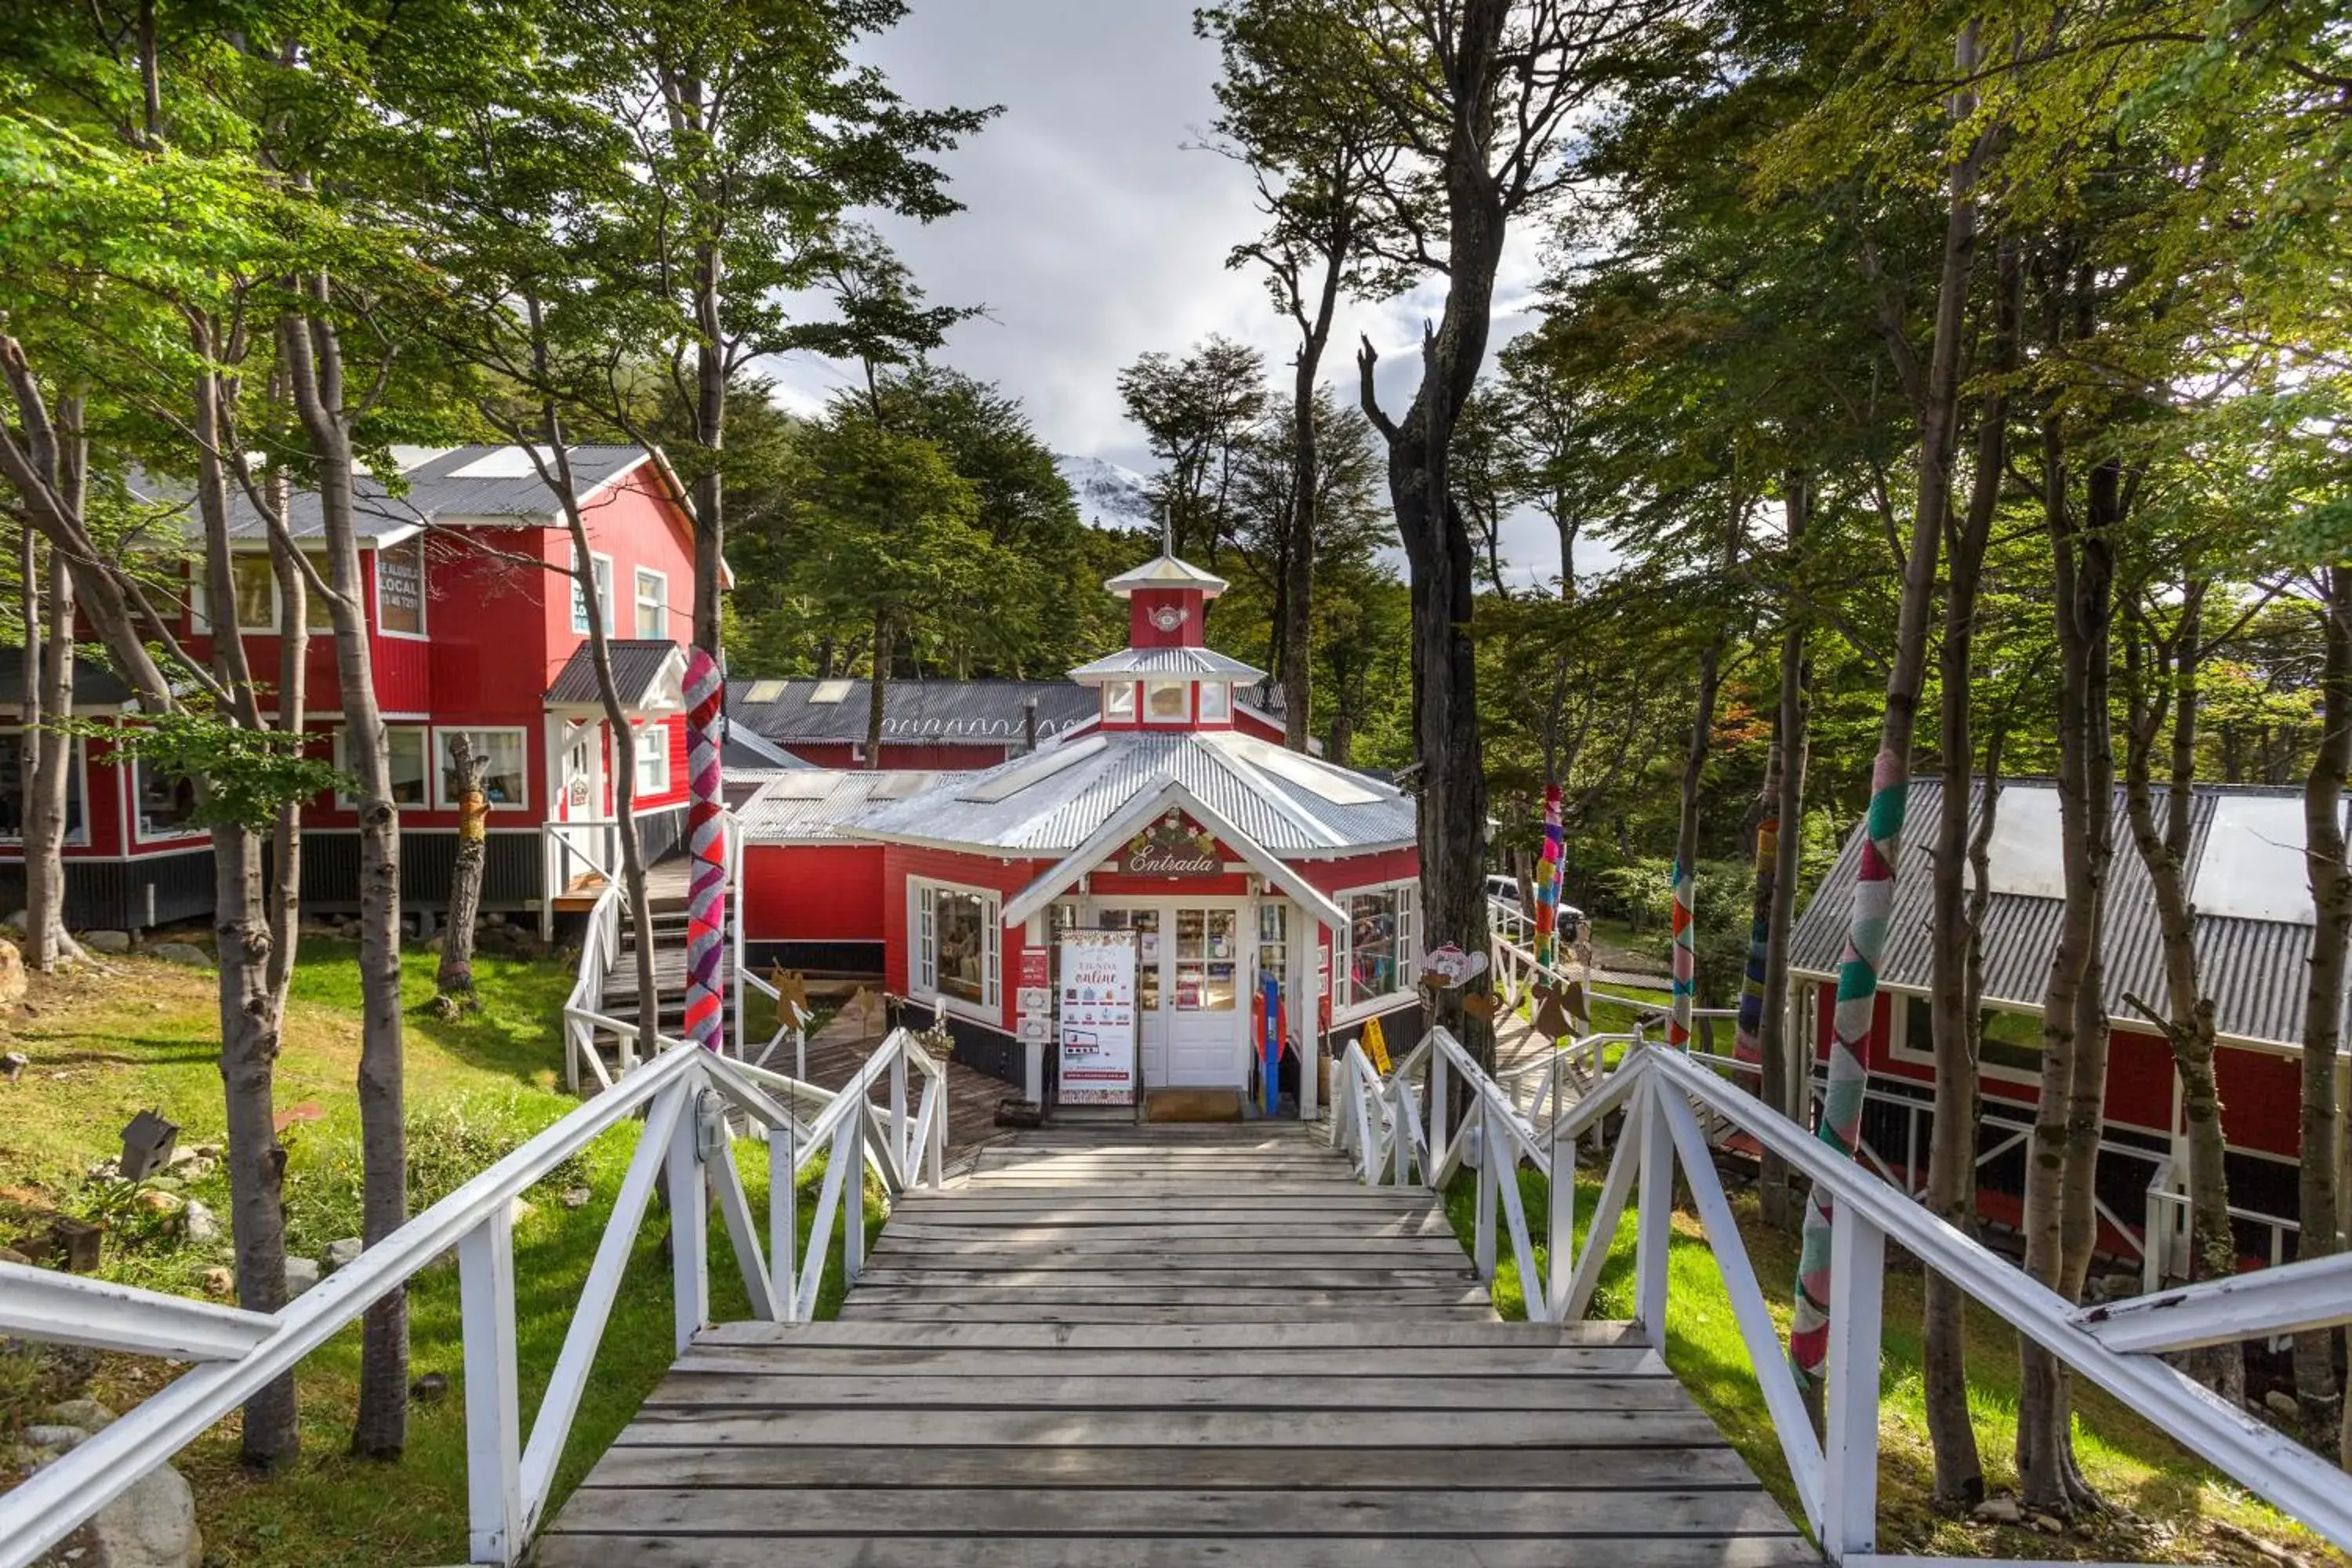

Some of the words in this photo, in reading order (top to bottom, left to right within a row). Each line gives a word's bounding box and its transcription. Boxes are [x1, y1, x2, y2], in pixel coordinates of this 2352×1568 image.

[379, 578, 417, 595] LOCAL
[1130, 844, 1214, 872] Entrada
[1079, 962, 1116, 971] TIENDA
[1075, 971, 1118, 984] online
